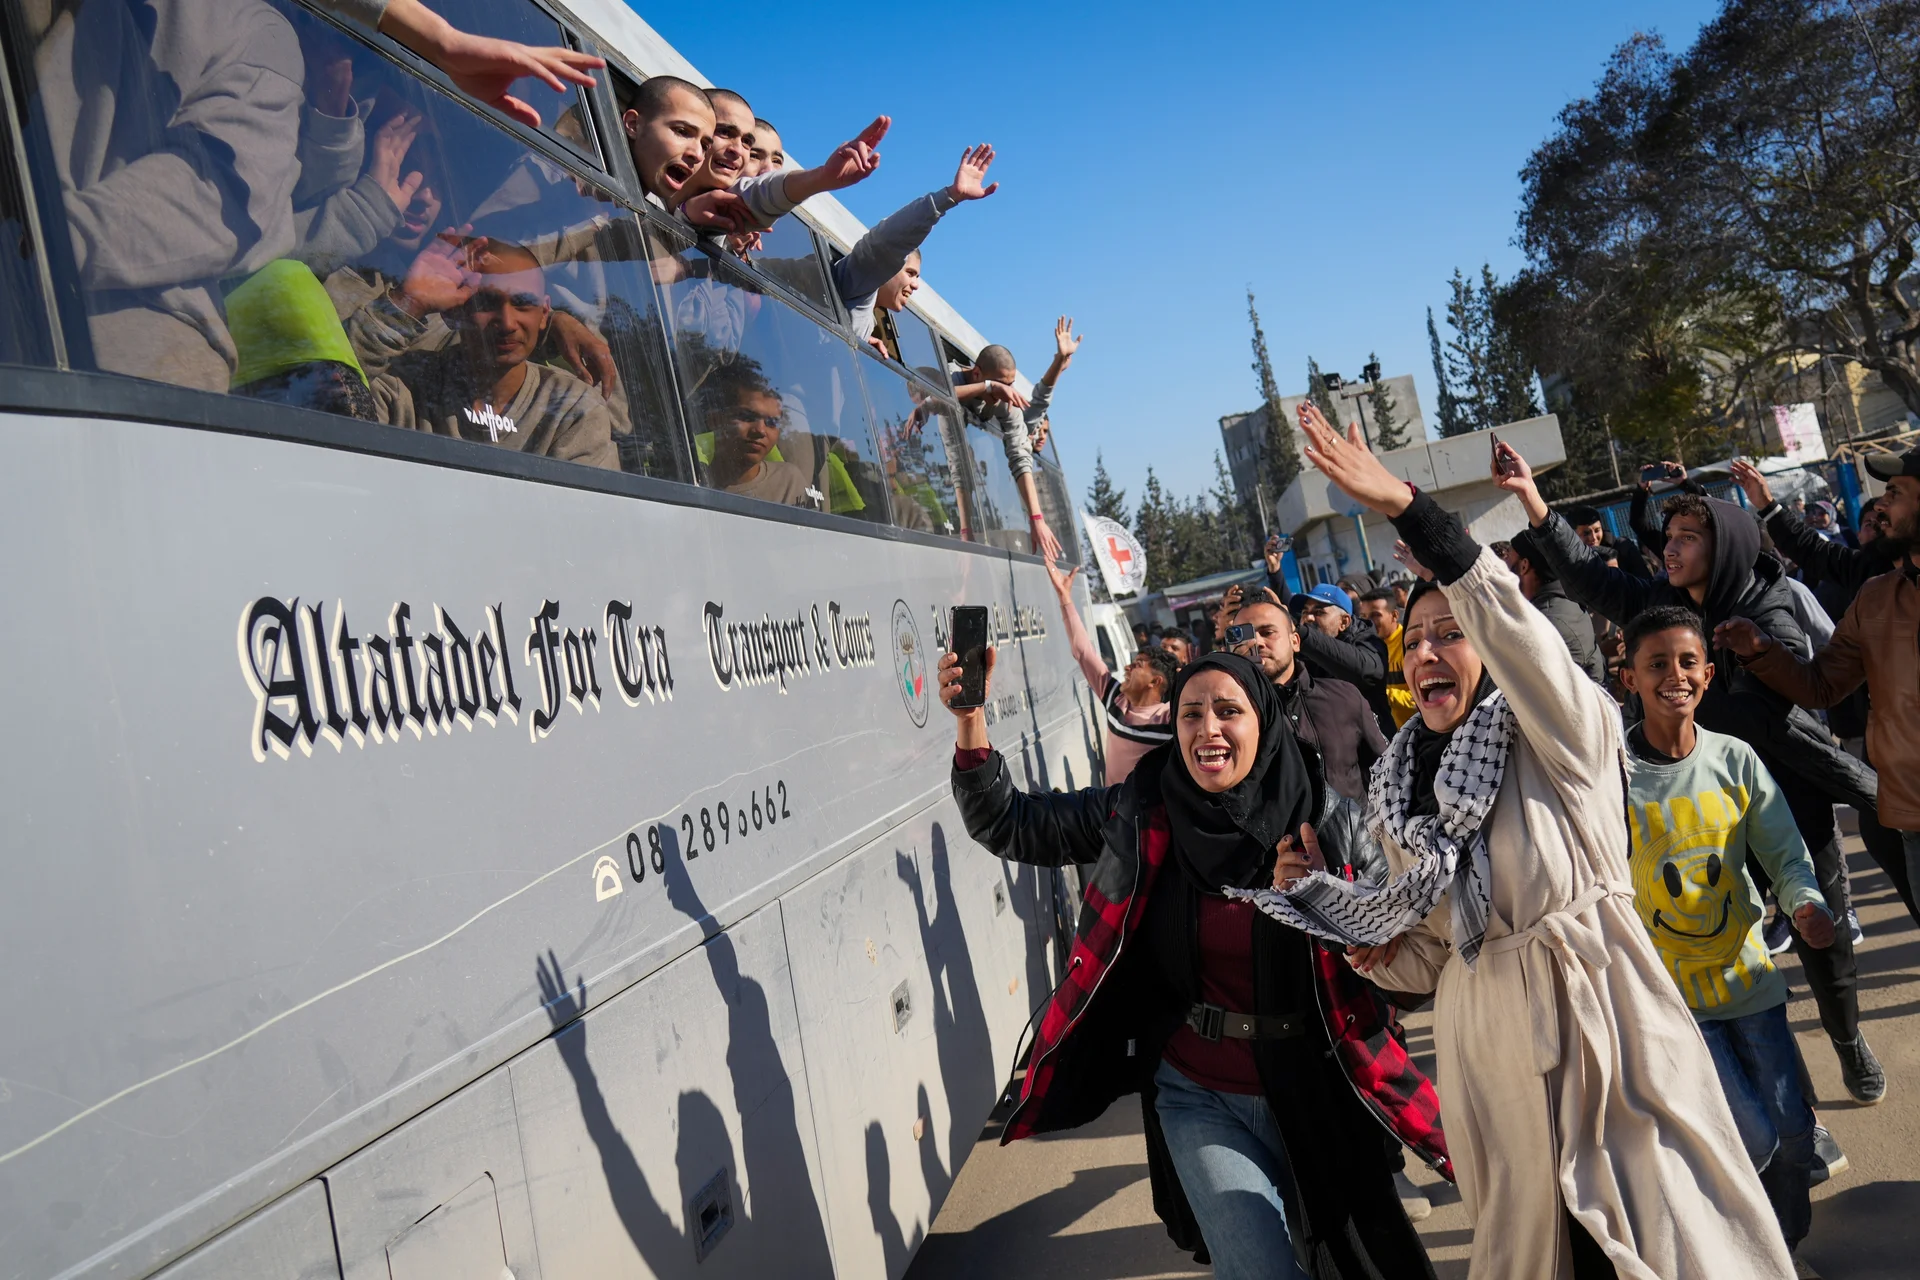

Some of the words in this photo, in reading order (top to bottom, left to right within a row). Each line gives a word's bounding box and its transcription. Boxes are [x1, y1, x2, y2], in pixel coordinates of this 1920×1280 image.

[239, 596, 521, 758] Altafadel
[526, 599, 602, 738] For
[605, 599, 674, 704] Tra
[703, 601, 810, 691] Transport
[810, 601, 830, 673] &
[826, 601, 875, 668] Tours
[626, 825, 665, 883] 08
